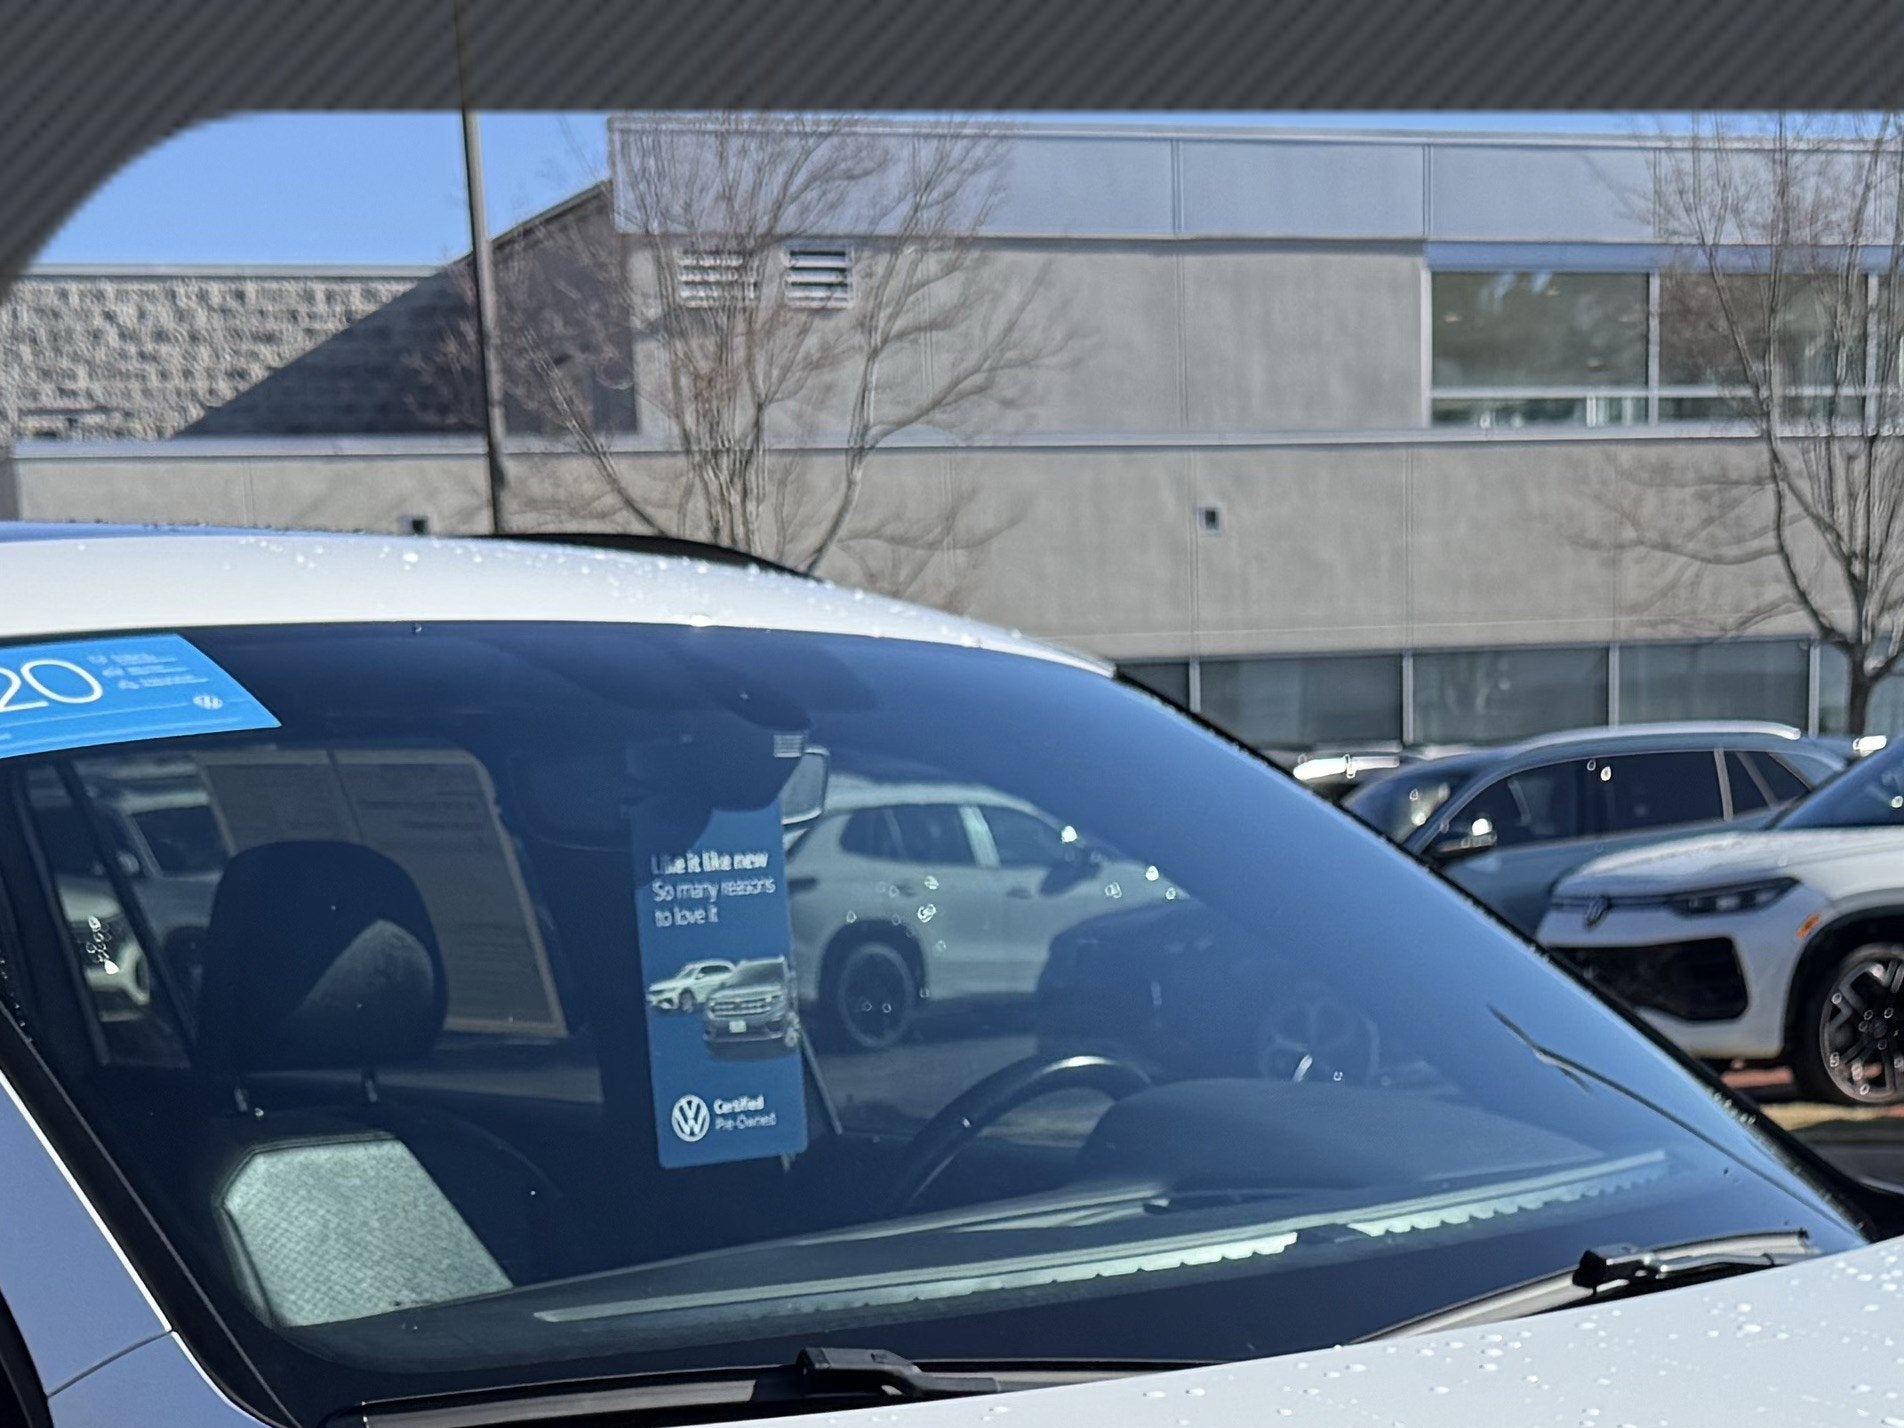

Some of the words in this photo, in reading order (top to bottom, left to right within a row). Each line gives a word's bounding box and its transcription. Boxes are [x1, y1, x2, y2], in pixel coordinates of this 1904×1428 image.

[733, 852, 768, 869] new
[652, 880, 675, 902] So
[676, 881, 718, 902] many
[721, 878, 776, 896] reasons
[654, 909, 672, 927] to
[673, 907, 706, 926] love
